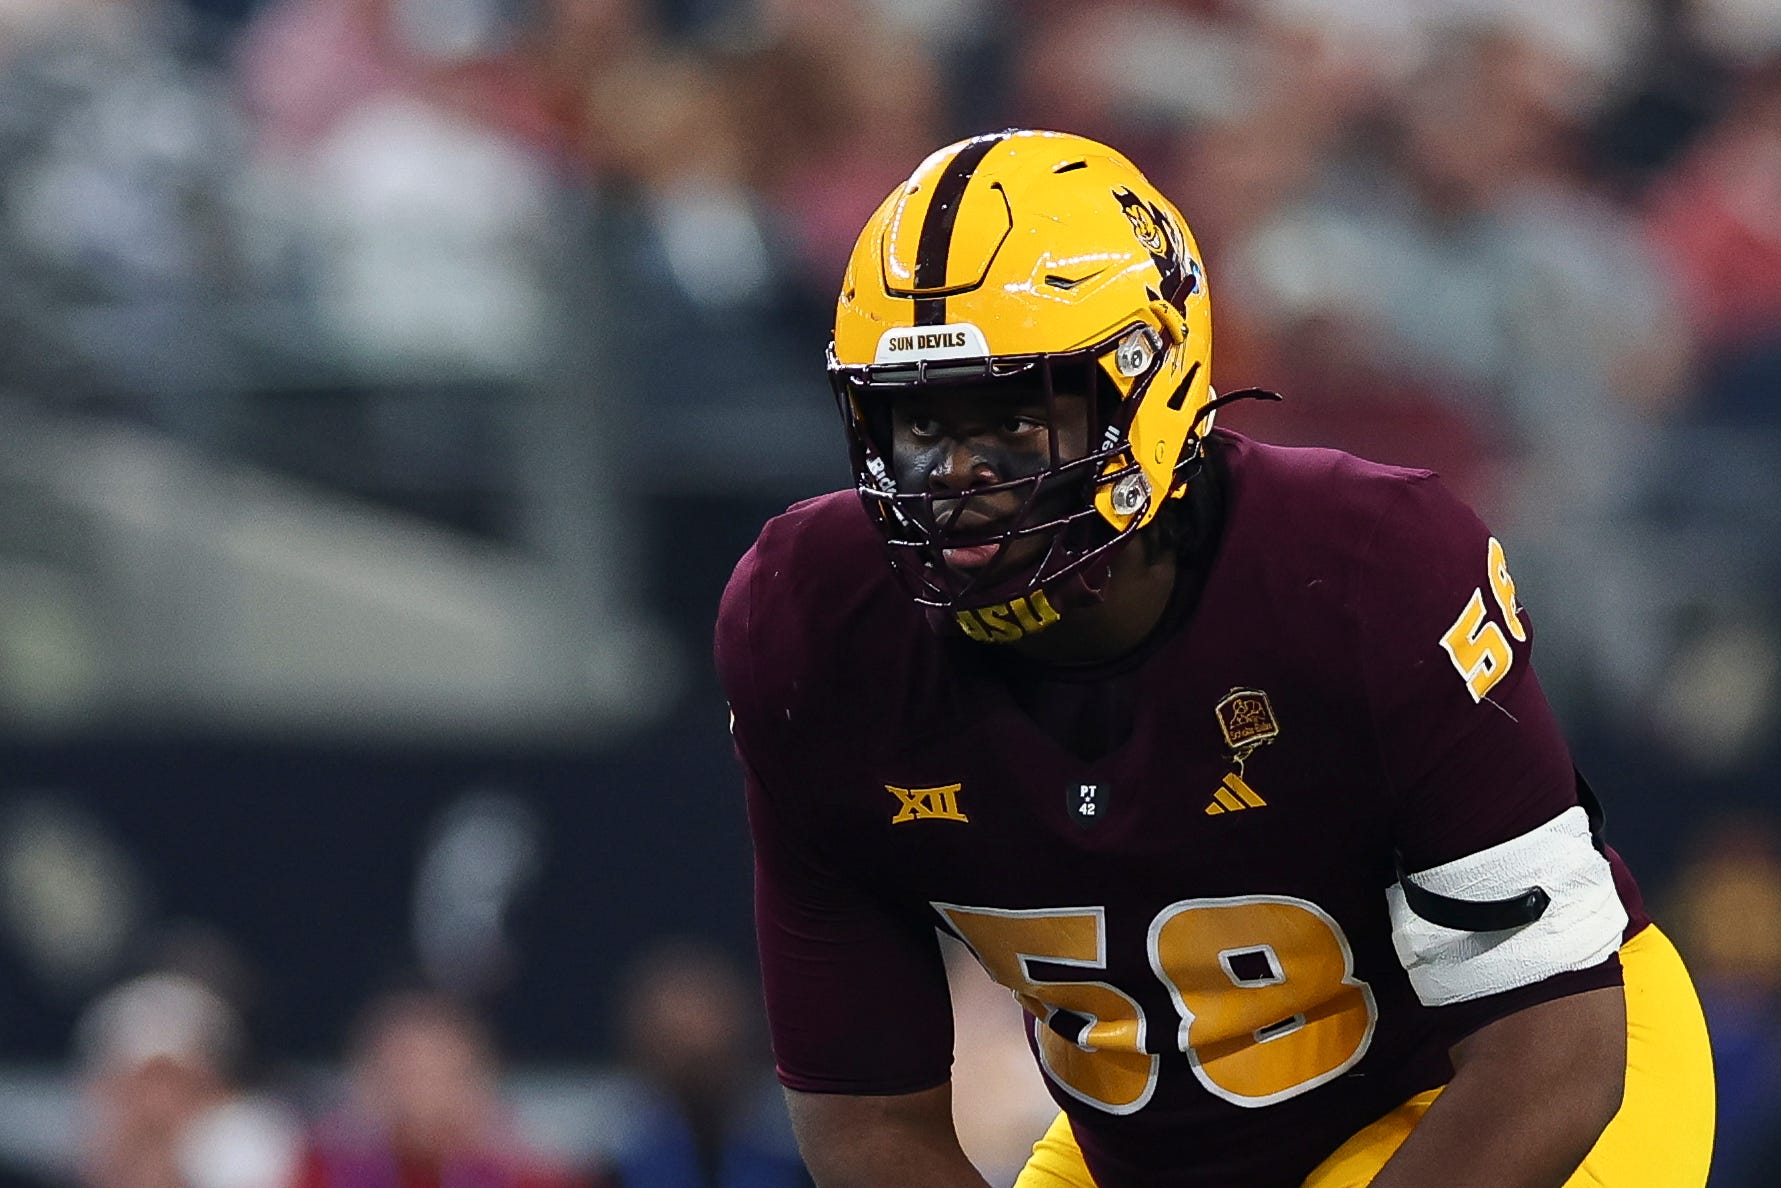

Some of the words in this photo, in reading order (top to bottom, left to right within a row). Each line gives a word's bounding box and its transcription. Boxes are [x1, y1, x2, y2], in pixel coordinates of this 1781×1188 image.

[889, 336, 914, 352] SUN
[917, 332, 966, 350] DEVILS
[1080, 785, 1097, 798] PT
[884, 783, 969, 824] XII
[1079, 803, 1096, 815] 42
[929, 894, 1378, 1116] 58
